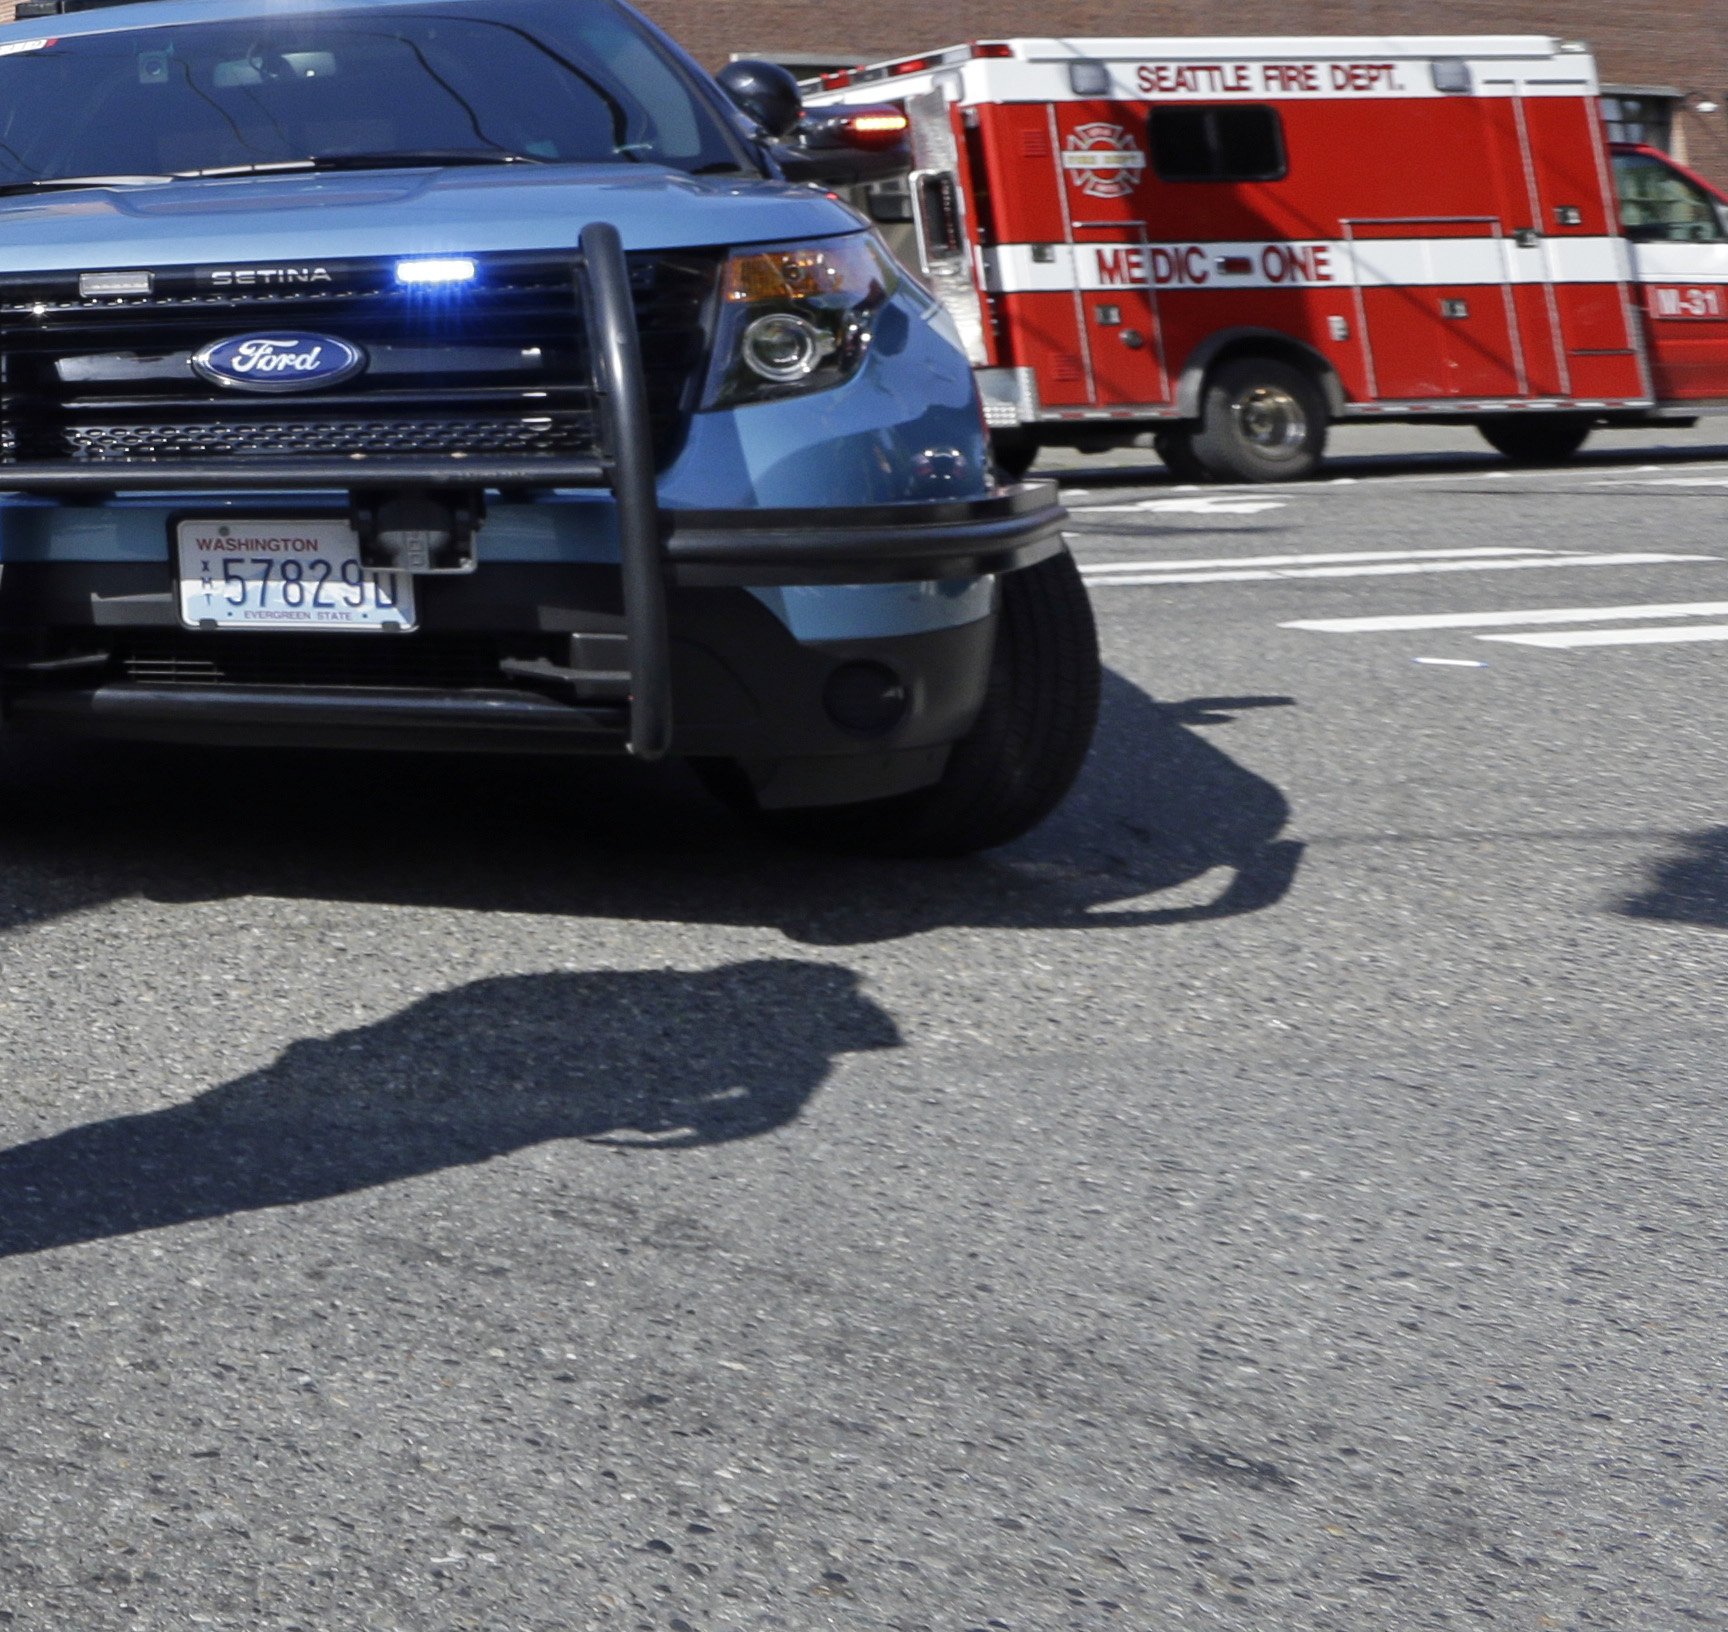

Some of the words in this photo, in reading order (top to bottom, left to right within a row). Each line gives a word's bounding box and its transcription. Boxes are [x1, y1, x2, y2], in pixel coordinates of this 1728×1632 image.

[1137, 65, 1253, 92] SEATTLE
[1262, 65, 1321, 91] FIRE
[1330, 64, 1405, 91] DEPT.
[211, 267, 332, 285] SETINA
[1095, 246, 1210, 284] MEDIC
[1262, 245, 1335, 283] ONE
[232, 339, 322, 372] Ford
[196, 538, 319, 552] WASHINGTON
[244, 610, 311, 619] EVERGREEN
[317, 611, 353, 620] STATE
